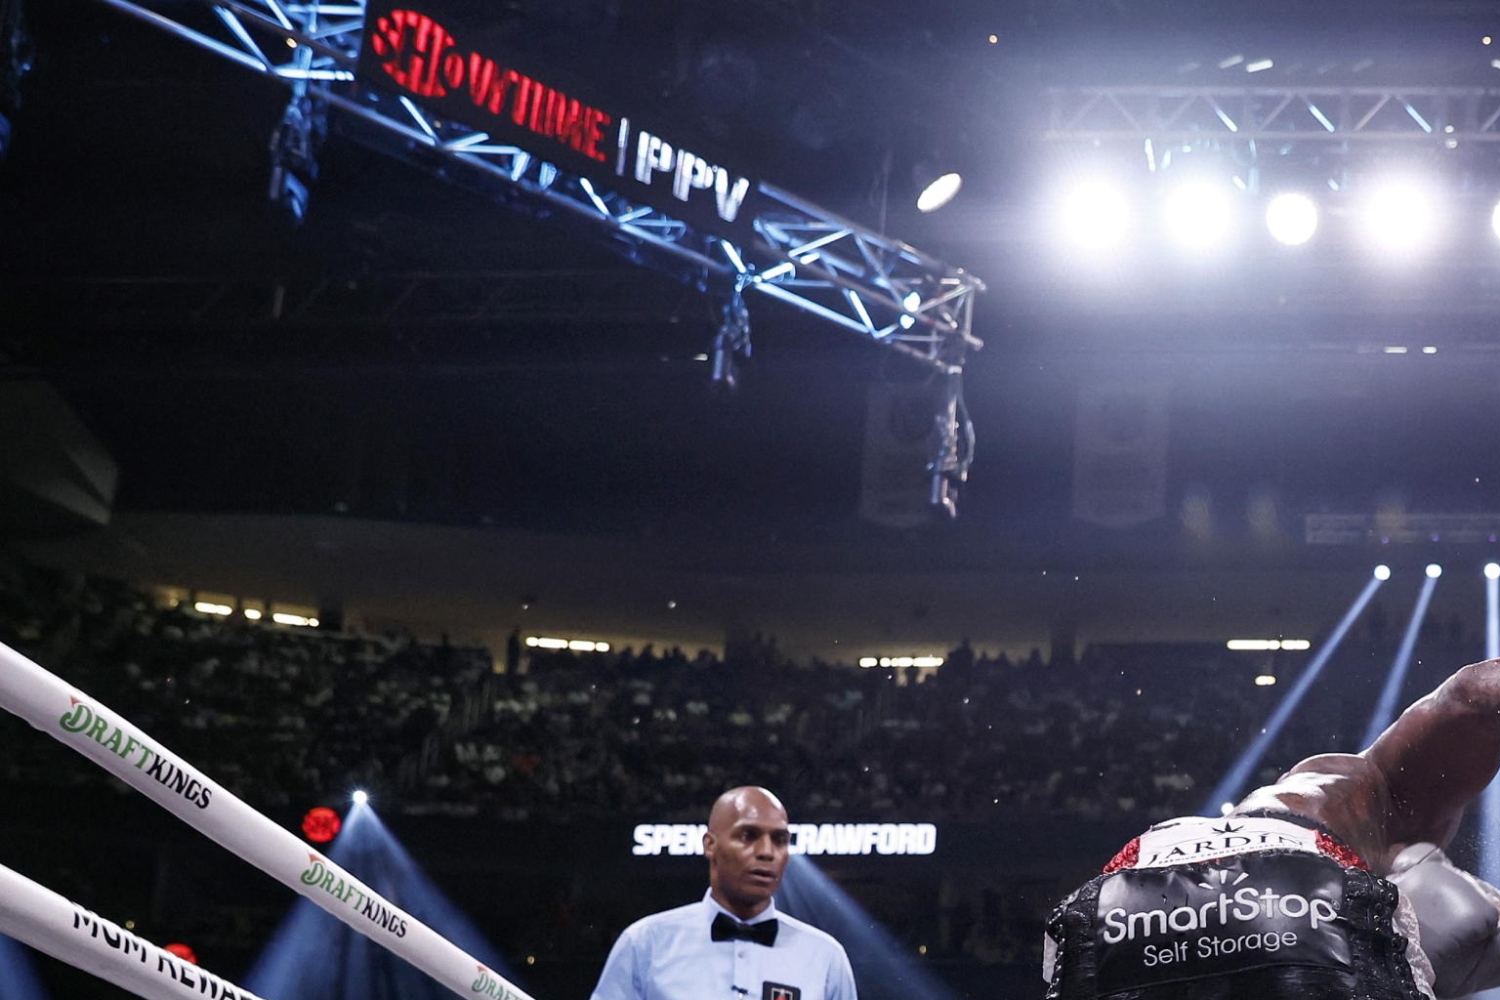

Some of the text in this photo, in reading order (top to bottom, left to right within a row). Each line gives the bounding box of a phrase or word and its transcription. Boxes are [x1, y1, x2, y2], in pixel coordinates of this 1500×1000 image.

[372, 9, 749, 222] SHOWTIME PPV
[60, 702, 212, 809] DRAFTKINGS
[632, 824, 937, 855] SPEN CRAWFORD
[301, 861, 408, 938] DRAFTKINGS
[1103, 887, 1339, 945] SmartStop
[1143, 931, 1298, 967] Self Storage
